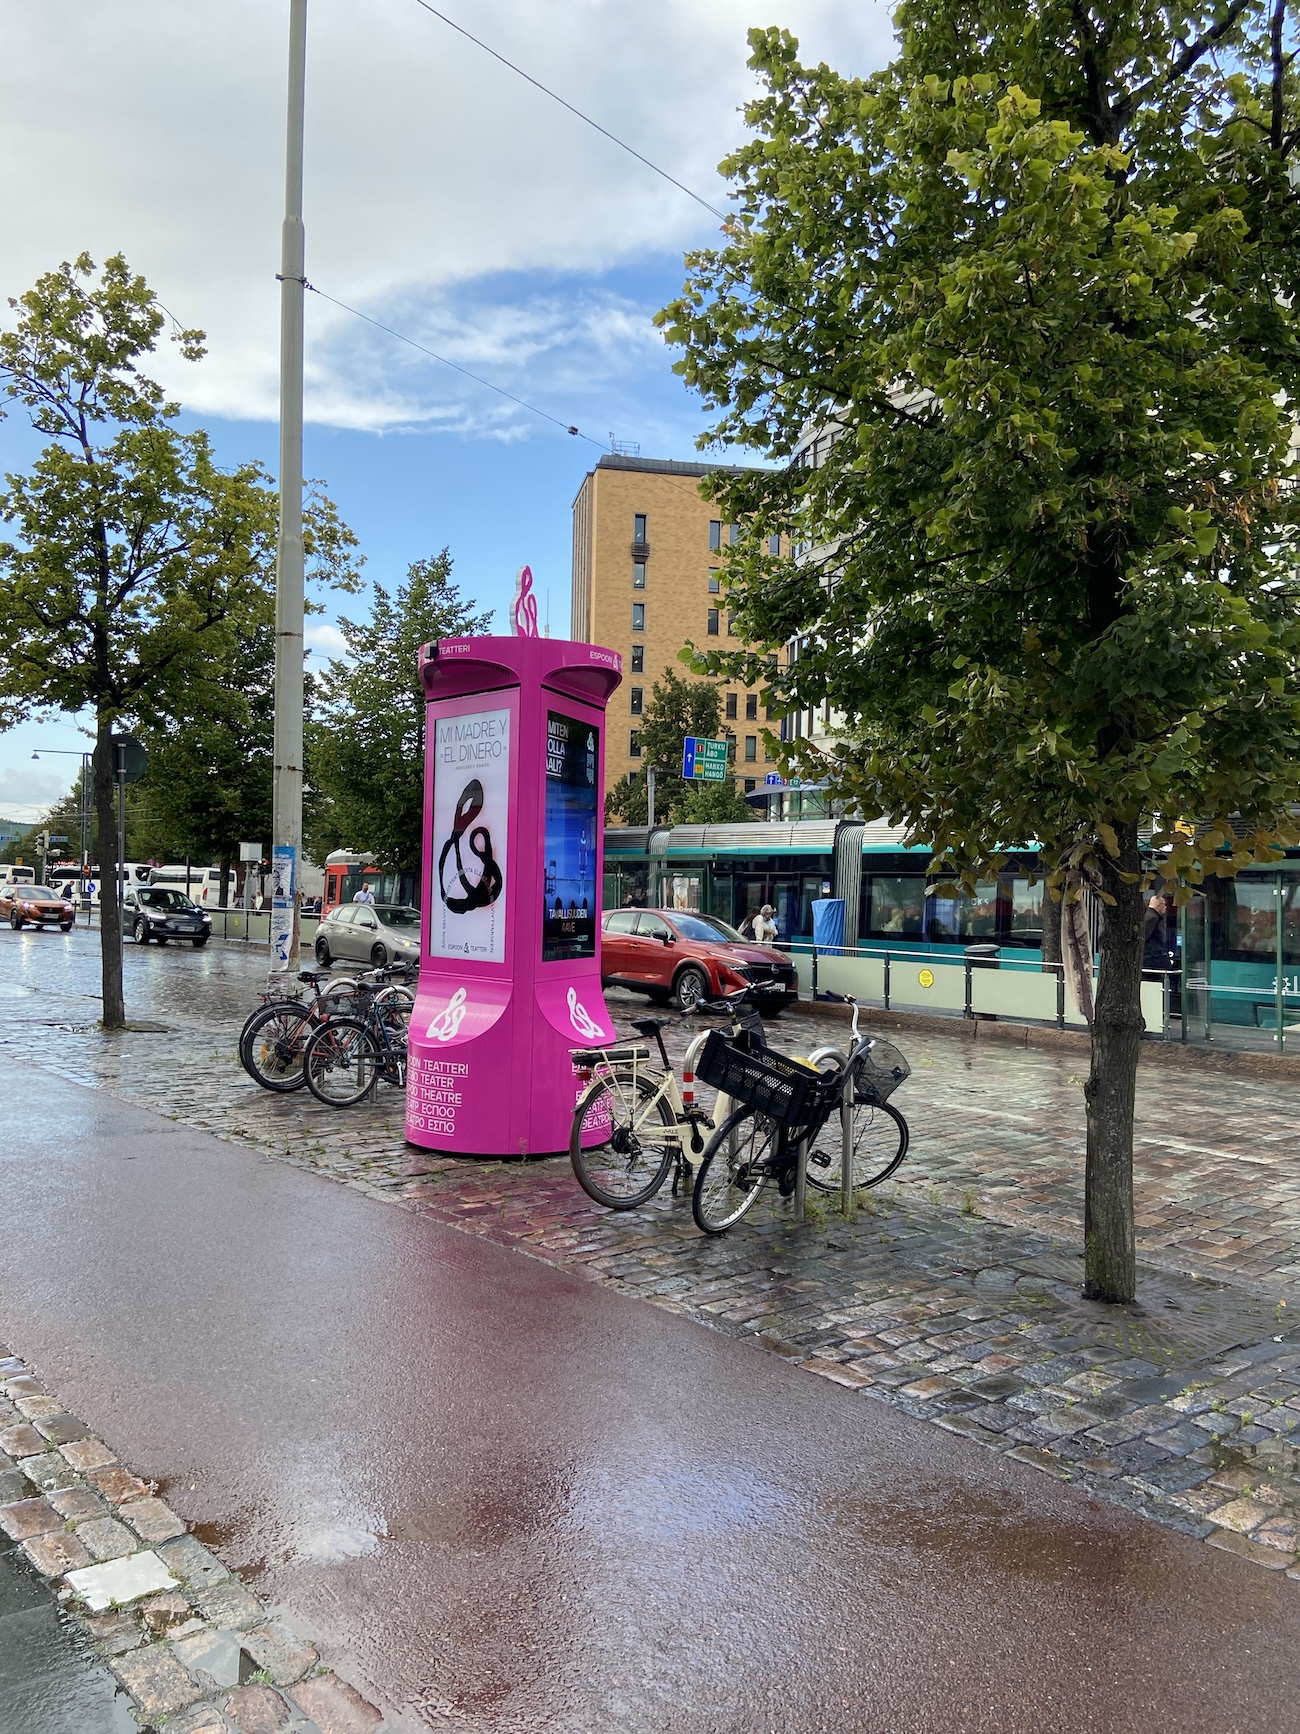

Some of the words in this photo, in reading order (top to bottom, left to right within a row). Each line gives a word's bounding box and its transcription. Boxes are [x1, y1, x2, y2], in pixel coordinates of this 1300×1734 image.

[439, 644, 471, 655] TEATTERI
[590, 650, 613, 664] ESPOON
[440, 726, 453, 744] MI
[455, 719, 496, 741] MADRE
[499, 718, 508, 735] Y
[547, 719, 569, 738] MITEN
[444, 746, 457, 764] EL
[459, 740, 502, 762] DINERO
[547, 738, 566, 756] OLLA
[706, 748, 719, 758] ÅBO
[707, 741, 726, 751] TURKU
[705, 762, 725, 771] HANKO
[423, 1059, 469, 1075] TEATTERI
[421, 1073, 455, 1089] TEATER
[420, 1088, 463, 1105] THEATRE
